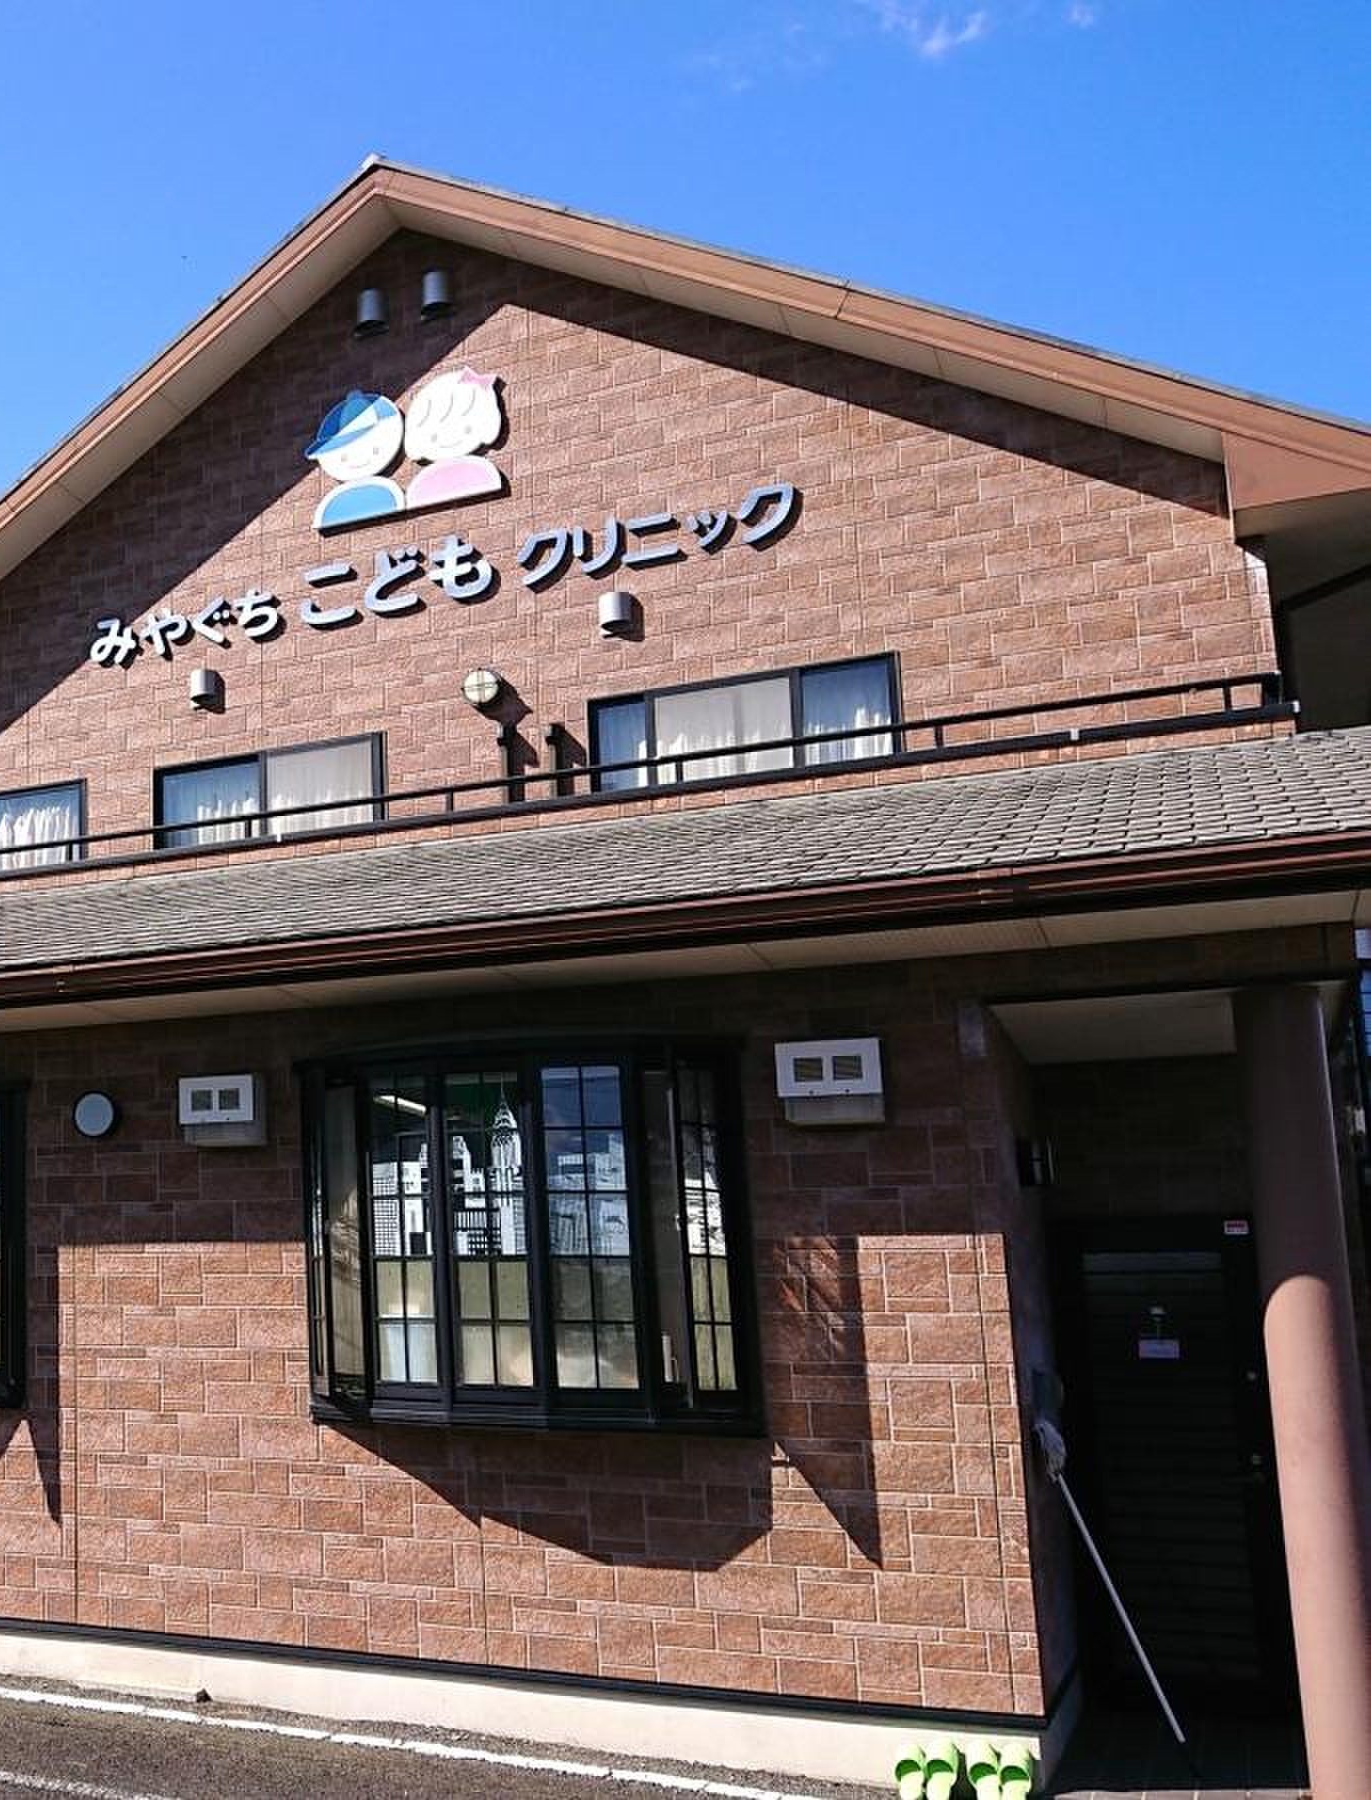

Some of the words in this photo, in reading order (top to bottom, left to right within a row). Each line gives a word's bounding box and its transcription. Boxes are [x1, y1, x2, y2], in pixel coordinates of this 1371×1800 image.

[90, 590, 280, 667] みやぐち
[302, 534, 493, 624] こども
[517, 482, 797, 586] クリニック
